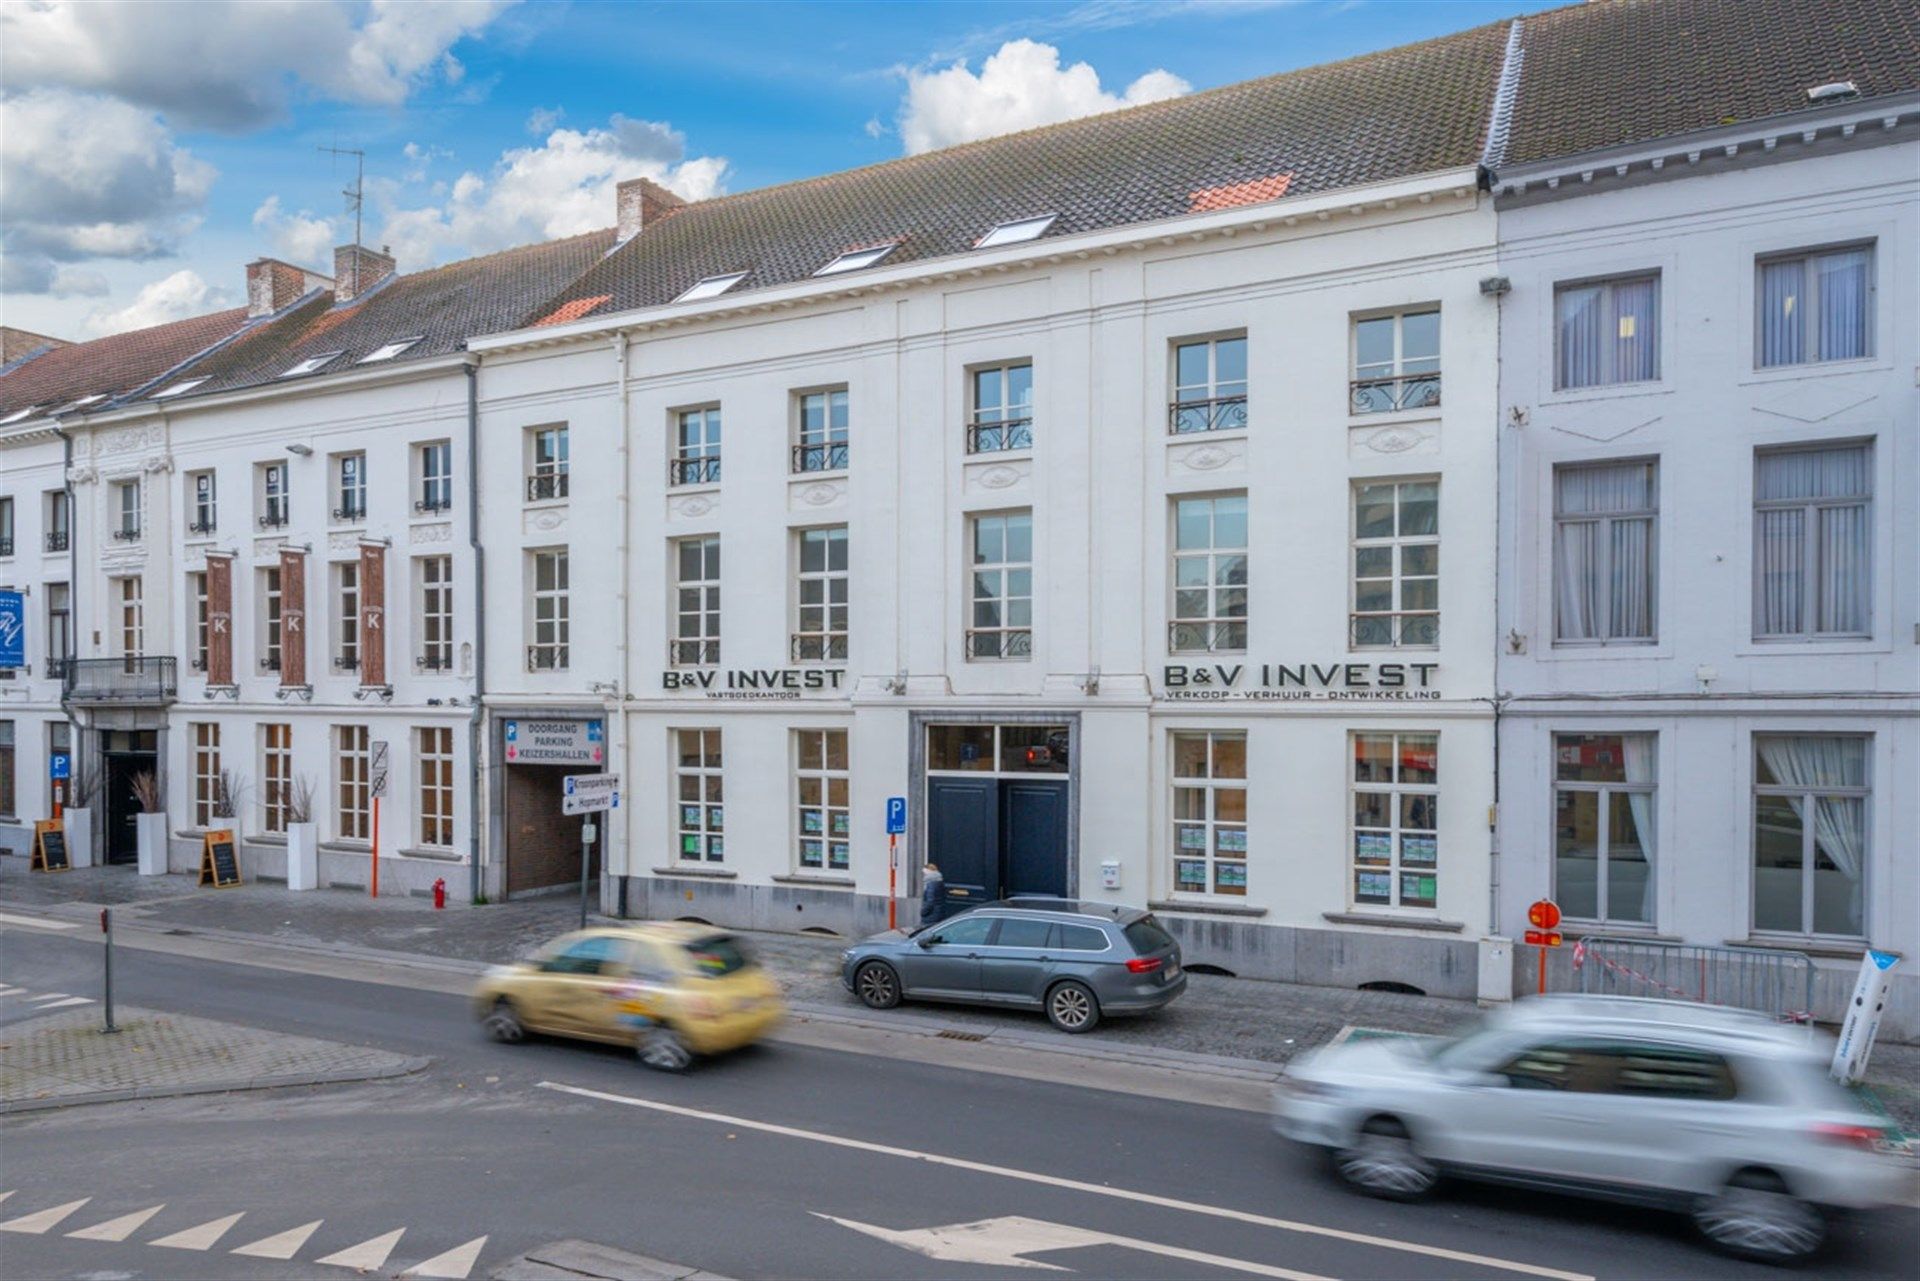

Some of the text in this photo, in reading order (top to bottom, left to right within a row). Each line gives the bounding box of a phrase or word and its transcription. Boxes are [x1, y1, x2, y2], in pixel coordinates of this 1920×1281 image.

[214, 619, 227, 633] K
[287, 617, 300, 632] K
[365, 613, 380, 629] K
[662, 669, 846, 689] B&V INVEST
[1164, 663, 1439, 687] B&V INVEST
[1167, 690, 1230, 699] VERKOOP
[1244, 690, 1312, 699] VERHUUR
[1328, 690, 1442, 699] ONTWIKKELING
[528, 723, 578, 734] DOORGANG
[534, 736, 574, 747] PARKING
[519, 748, 591, 760] KEIZERSHALLEN
[54, 756, 66, 769] P
[892, 800, 901, 819] P
